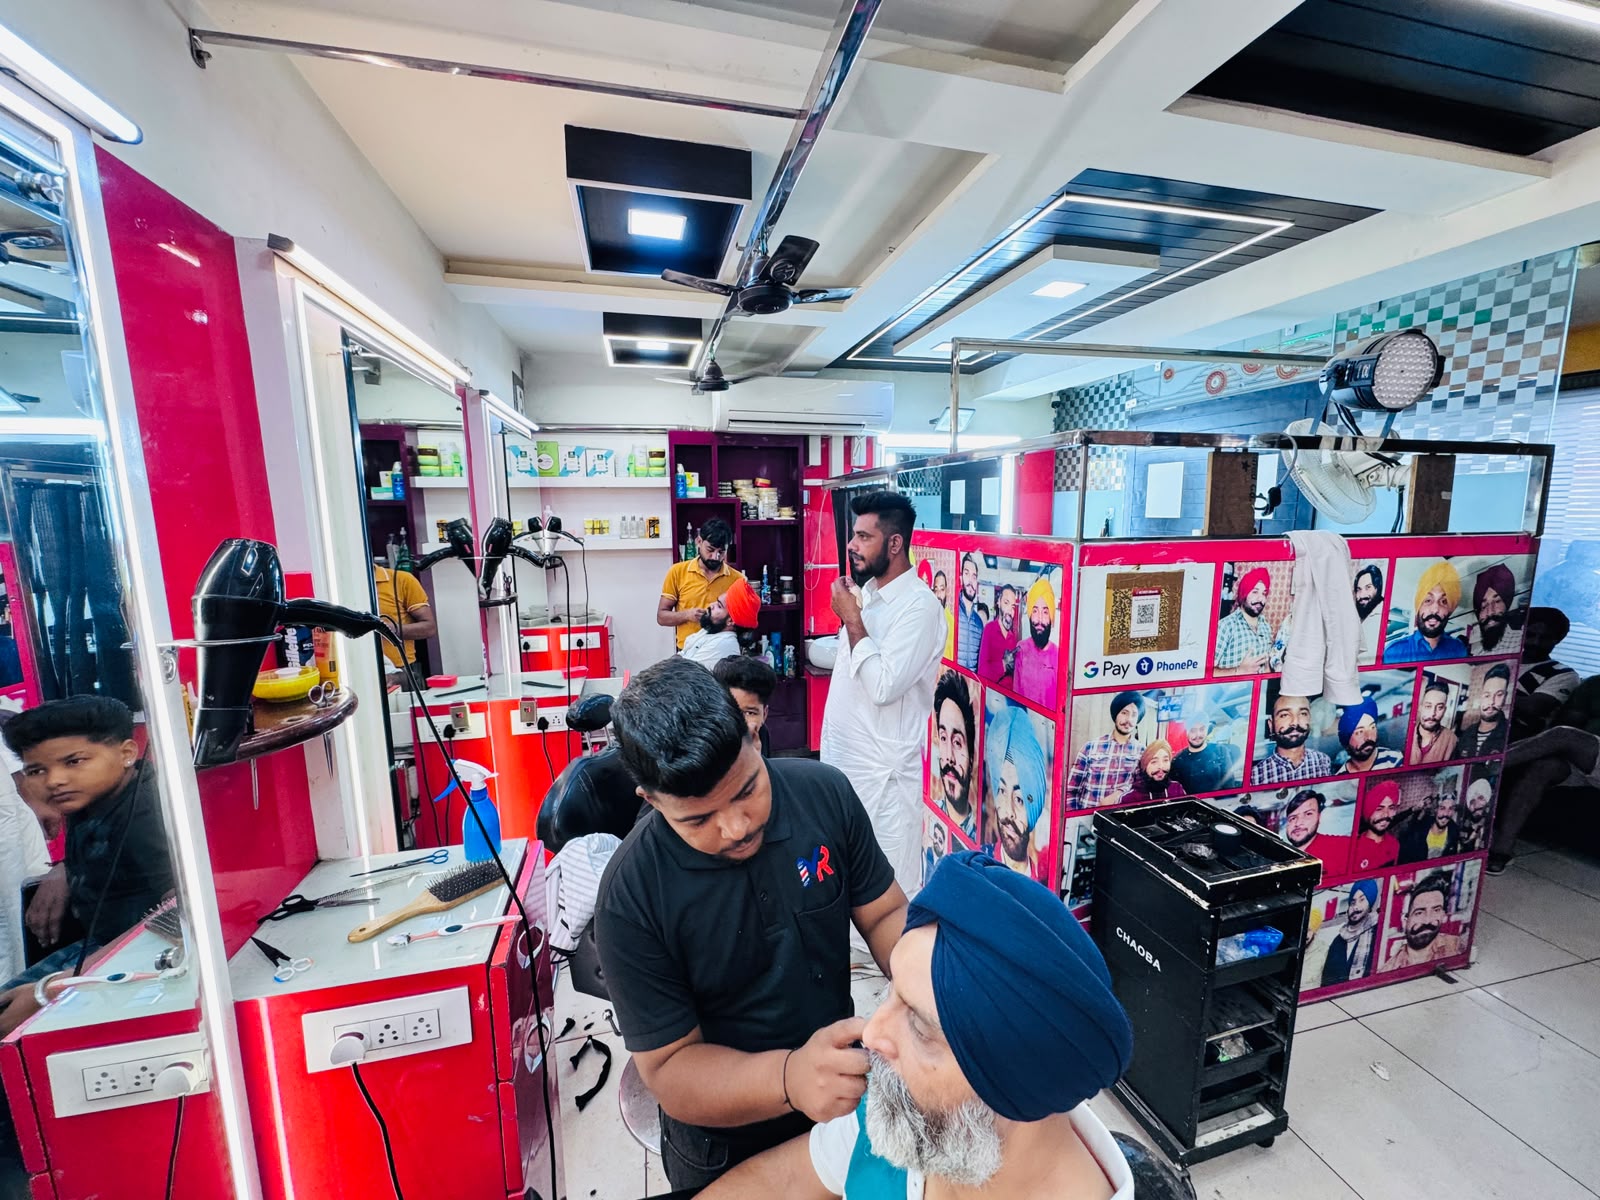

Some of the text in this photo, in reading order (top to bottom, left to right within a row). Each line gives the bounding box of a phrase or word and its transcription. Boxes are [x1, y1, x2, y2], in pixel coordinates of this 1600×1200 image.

[1103, 661, 1130, 679] Pay
[1156, 659, 1198, 671] PhonePe
[1116, 926, 1161, 972] CHAOBA
